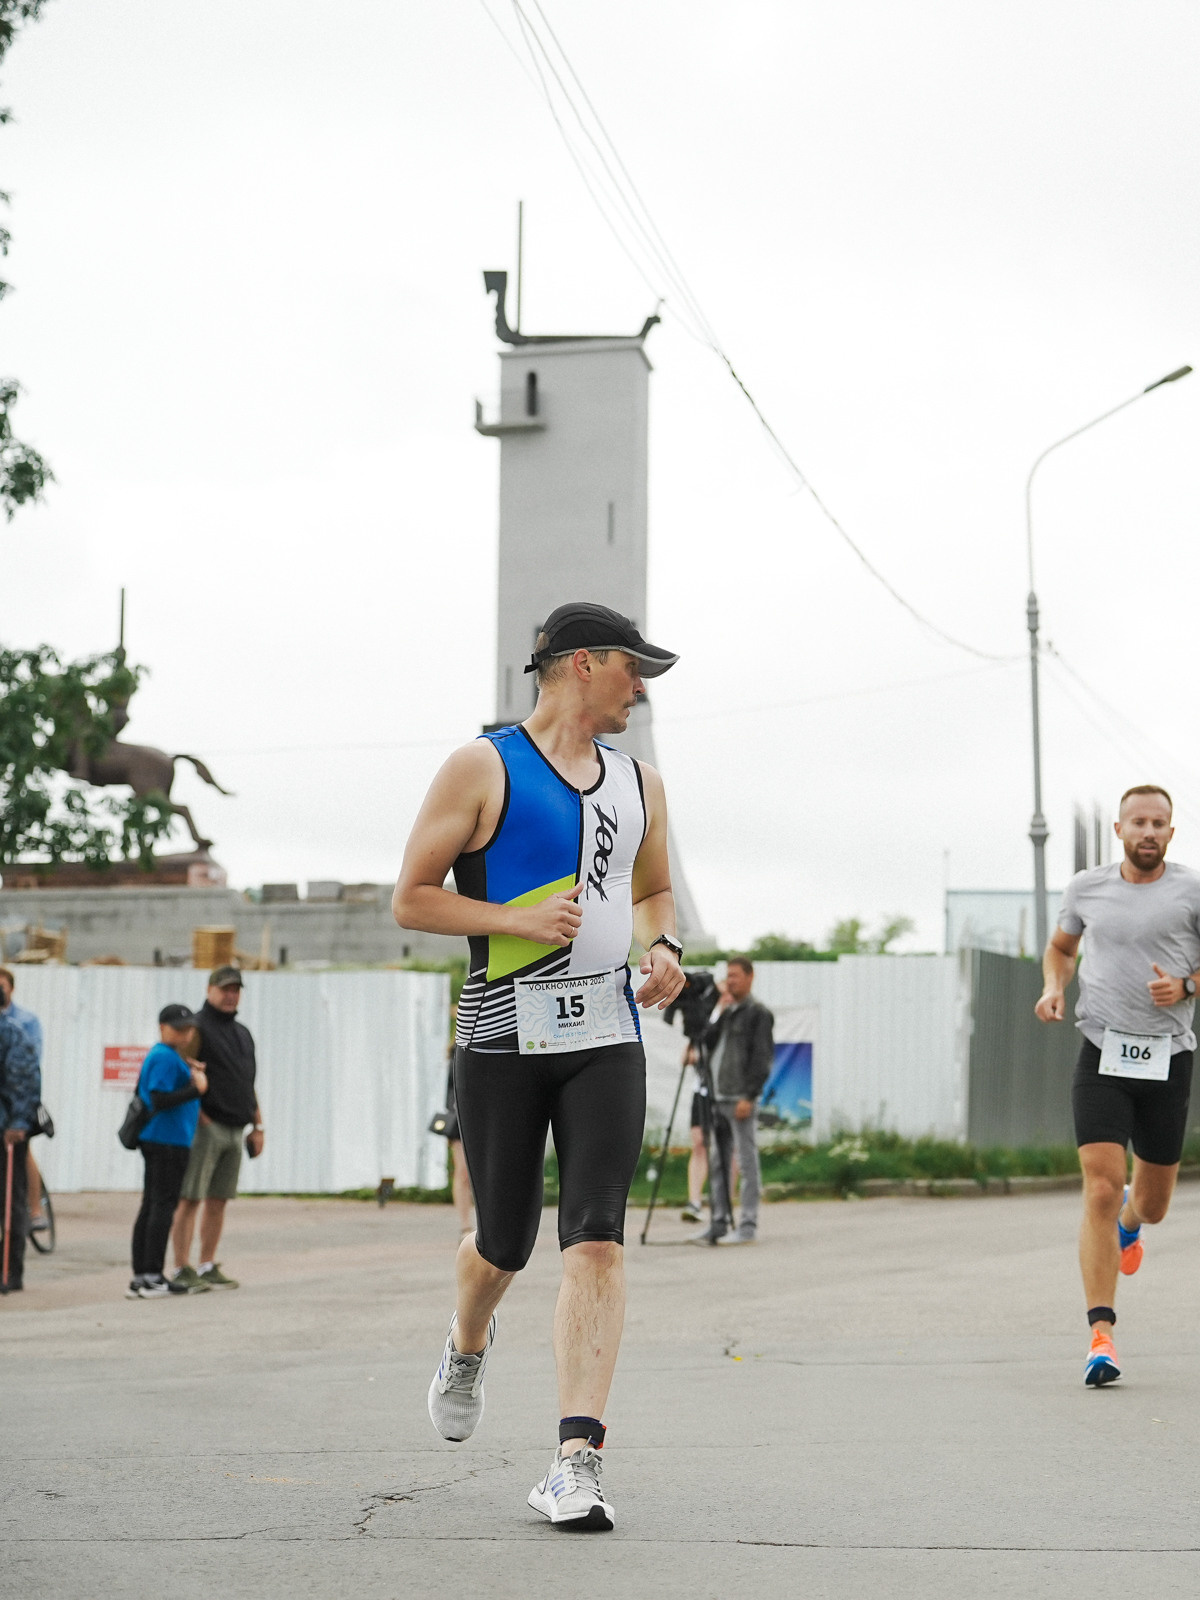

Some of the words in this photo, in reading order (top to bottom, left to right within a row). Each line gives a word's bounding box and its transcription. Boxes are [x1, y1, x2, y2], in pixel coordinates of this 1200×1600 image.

[529, 981, 588, 991] VOLKHOVMAN
[590, 977, 605, 985] 2023
[556, 995, 585, 1019] 15
[558, 1020, 585, 1028] МИХАИЛ
[1121, 1044, 1151, 1060] 106
